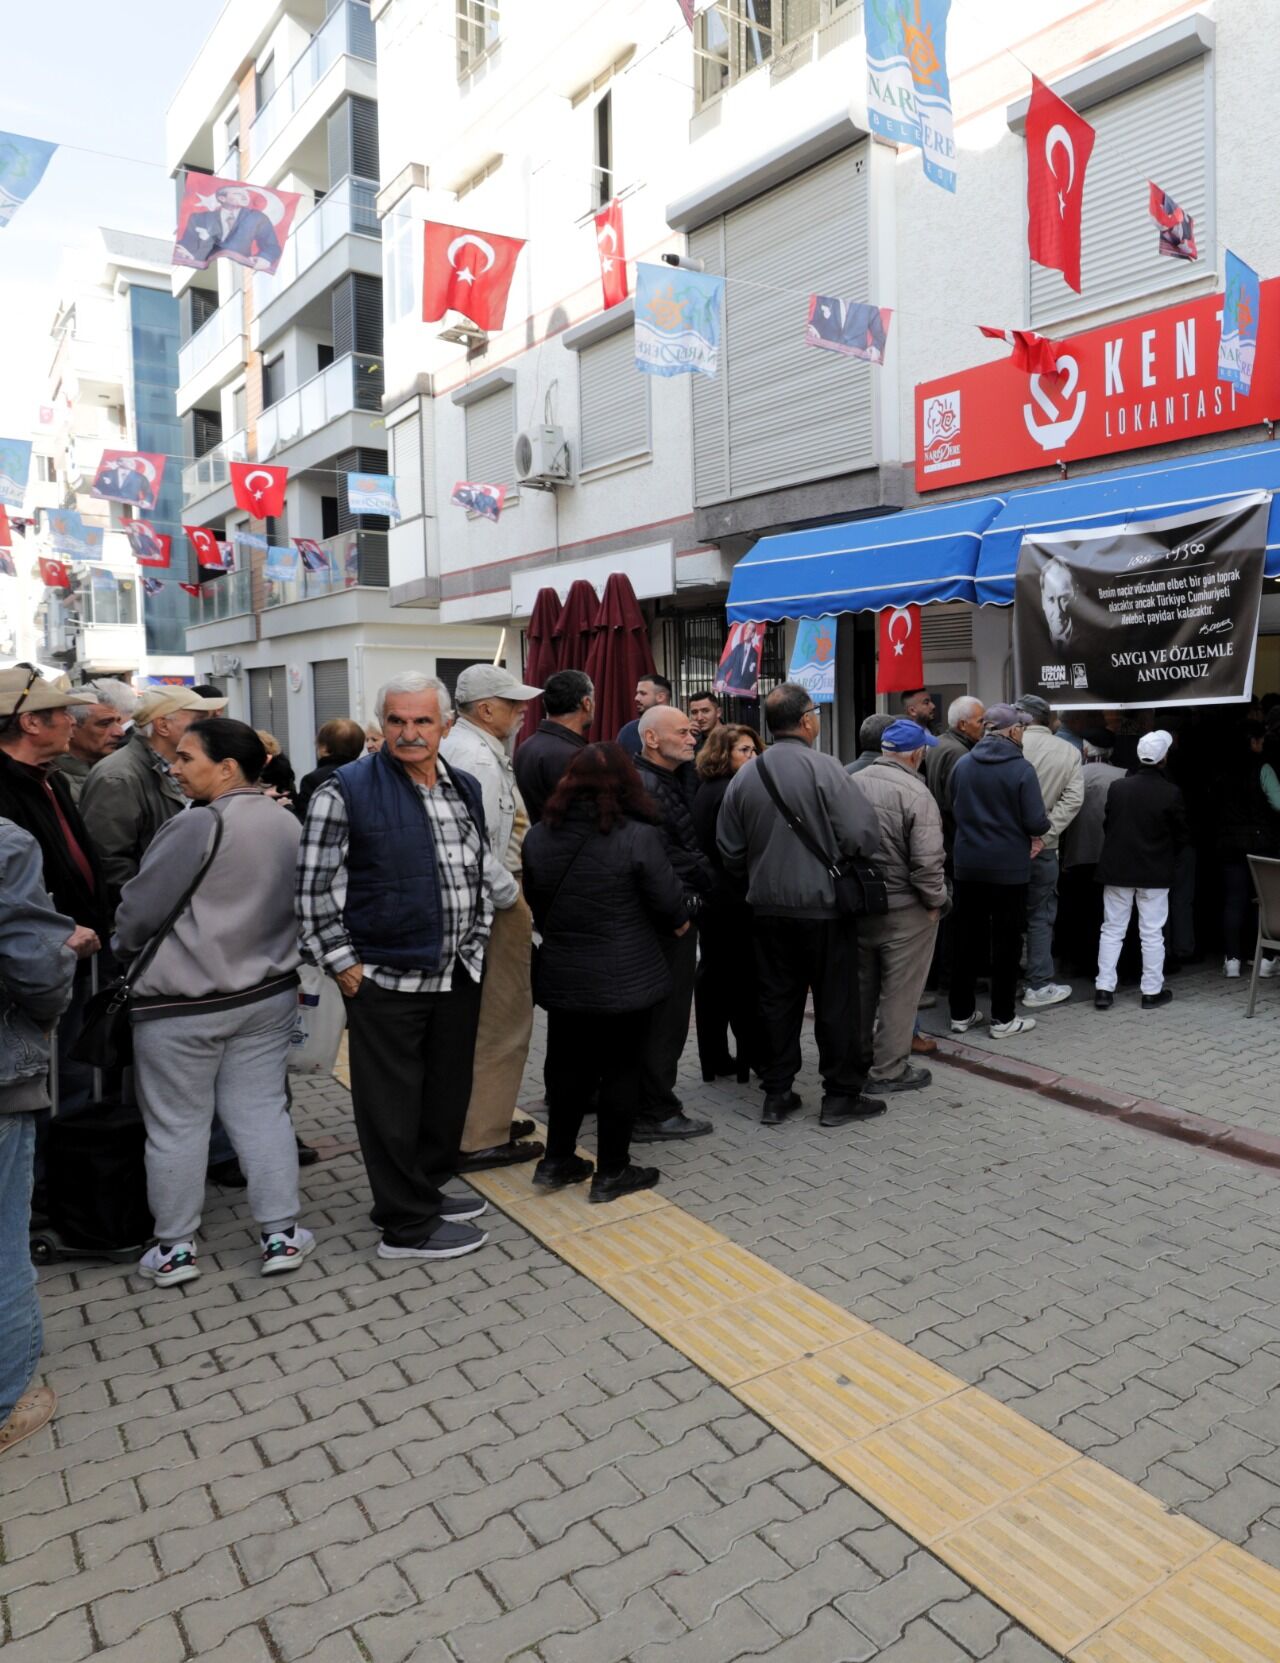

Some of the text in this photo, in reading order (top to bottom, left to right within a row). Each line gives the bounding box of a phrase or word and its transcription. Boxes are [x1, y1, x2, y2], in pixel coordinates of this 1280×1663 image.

[1105, 381, 1237, 437] LOKANTASI
[1134, 580, 1166, 595] vücudum
[1167, 577, 1188, 590] elbet
[1189, 575, 1201, 587] bir
[1203, 574, 1216, 588] gün
[1217, 568, 1240, 583] toprak
[1135, 597, 1156, 610] ancak
[1157, 593, 1186, 608] Türkiye
[1188, 585, 1230, 603] Cumhuriyeti
[1147, 610, 1175, 626] payidar
[1111, 642, 1234, 668] SAYGI VE ÖZLEMLE
[1041, 671, 1066, 682] UZUN
[1137, 662, 1210, 684] ANIYORUZ
